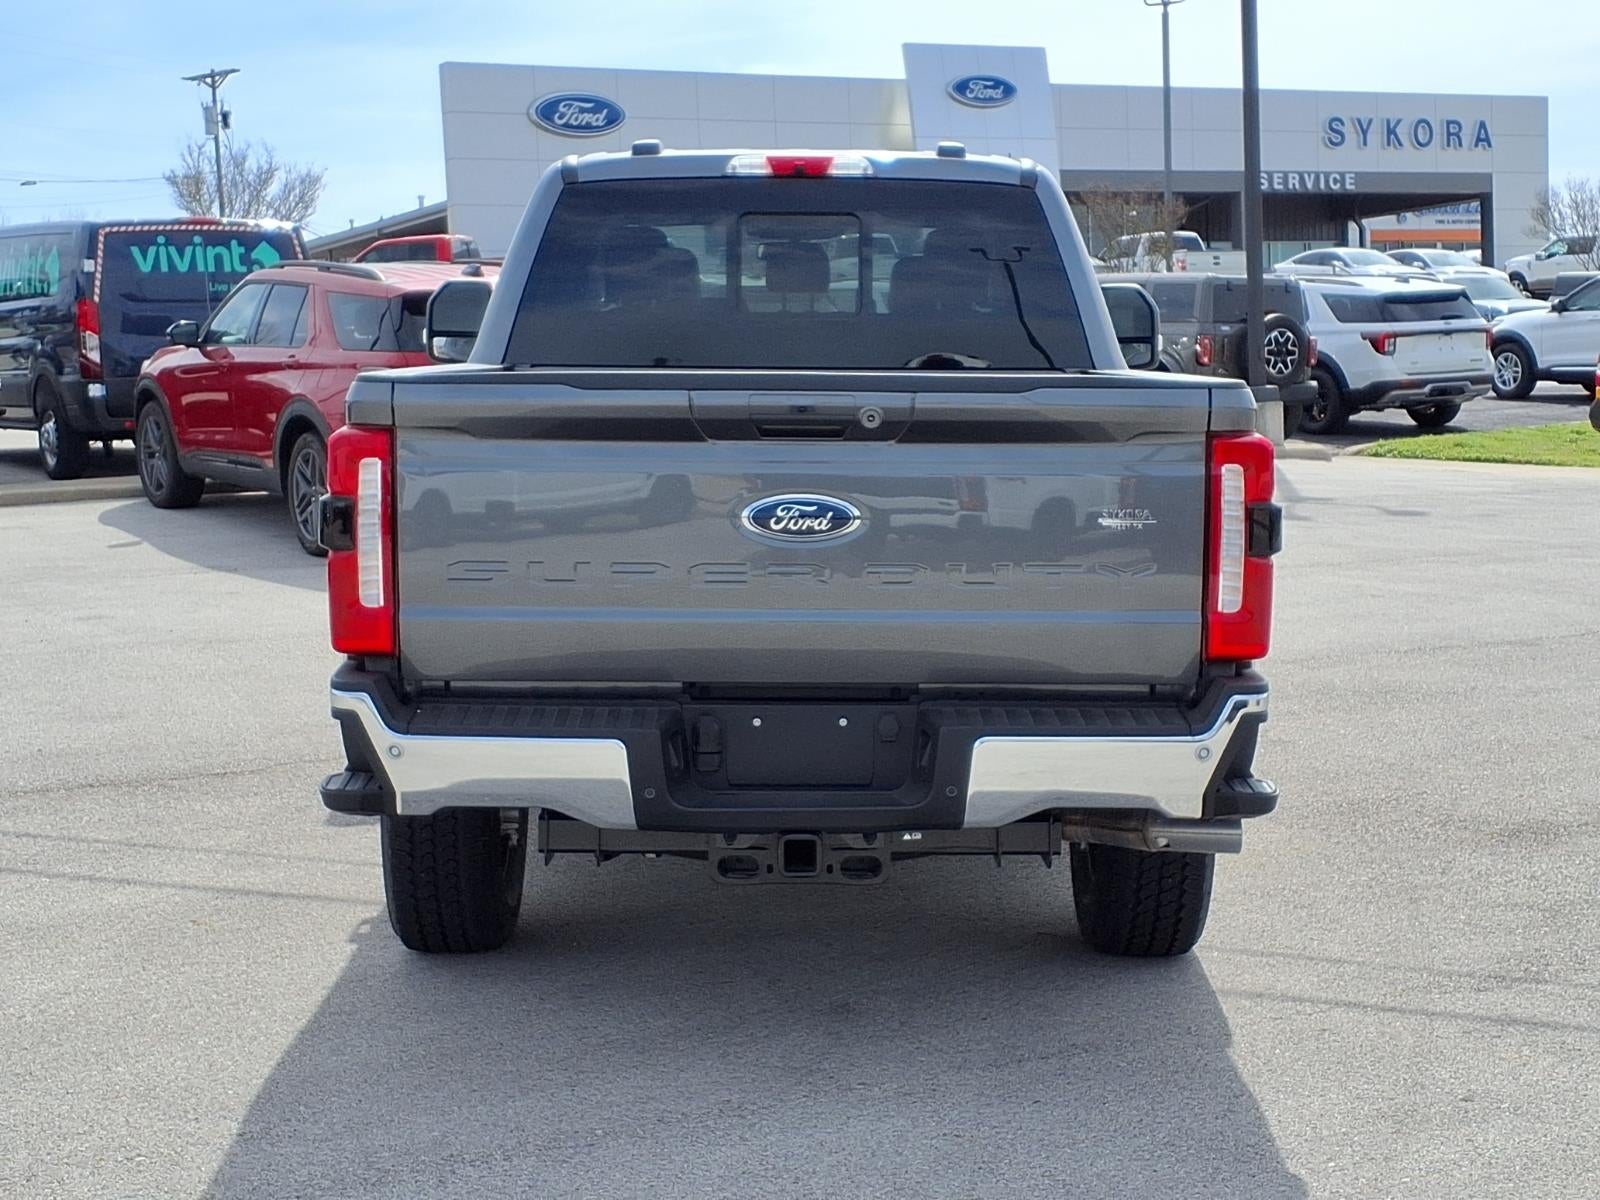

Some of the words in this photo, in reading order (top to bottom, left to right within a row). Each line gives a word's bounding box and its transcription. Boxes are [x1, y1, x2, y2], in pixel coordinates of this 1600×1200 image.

[966, 79, 1005, 99] Ford
[554, 100, 609, 126] Ford
[1325, 116, 1493, 150] SYKORA
[1260, 172, 1356, 190] SERVICE
[129, 234, 248, 273] vivint
[770, 503, 834, 531] Ford
[447, 559, 833, 588] SUPER
[862, 561, 1158, 590] DUTY
